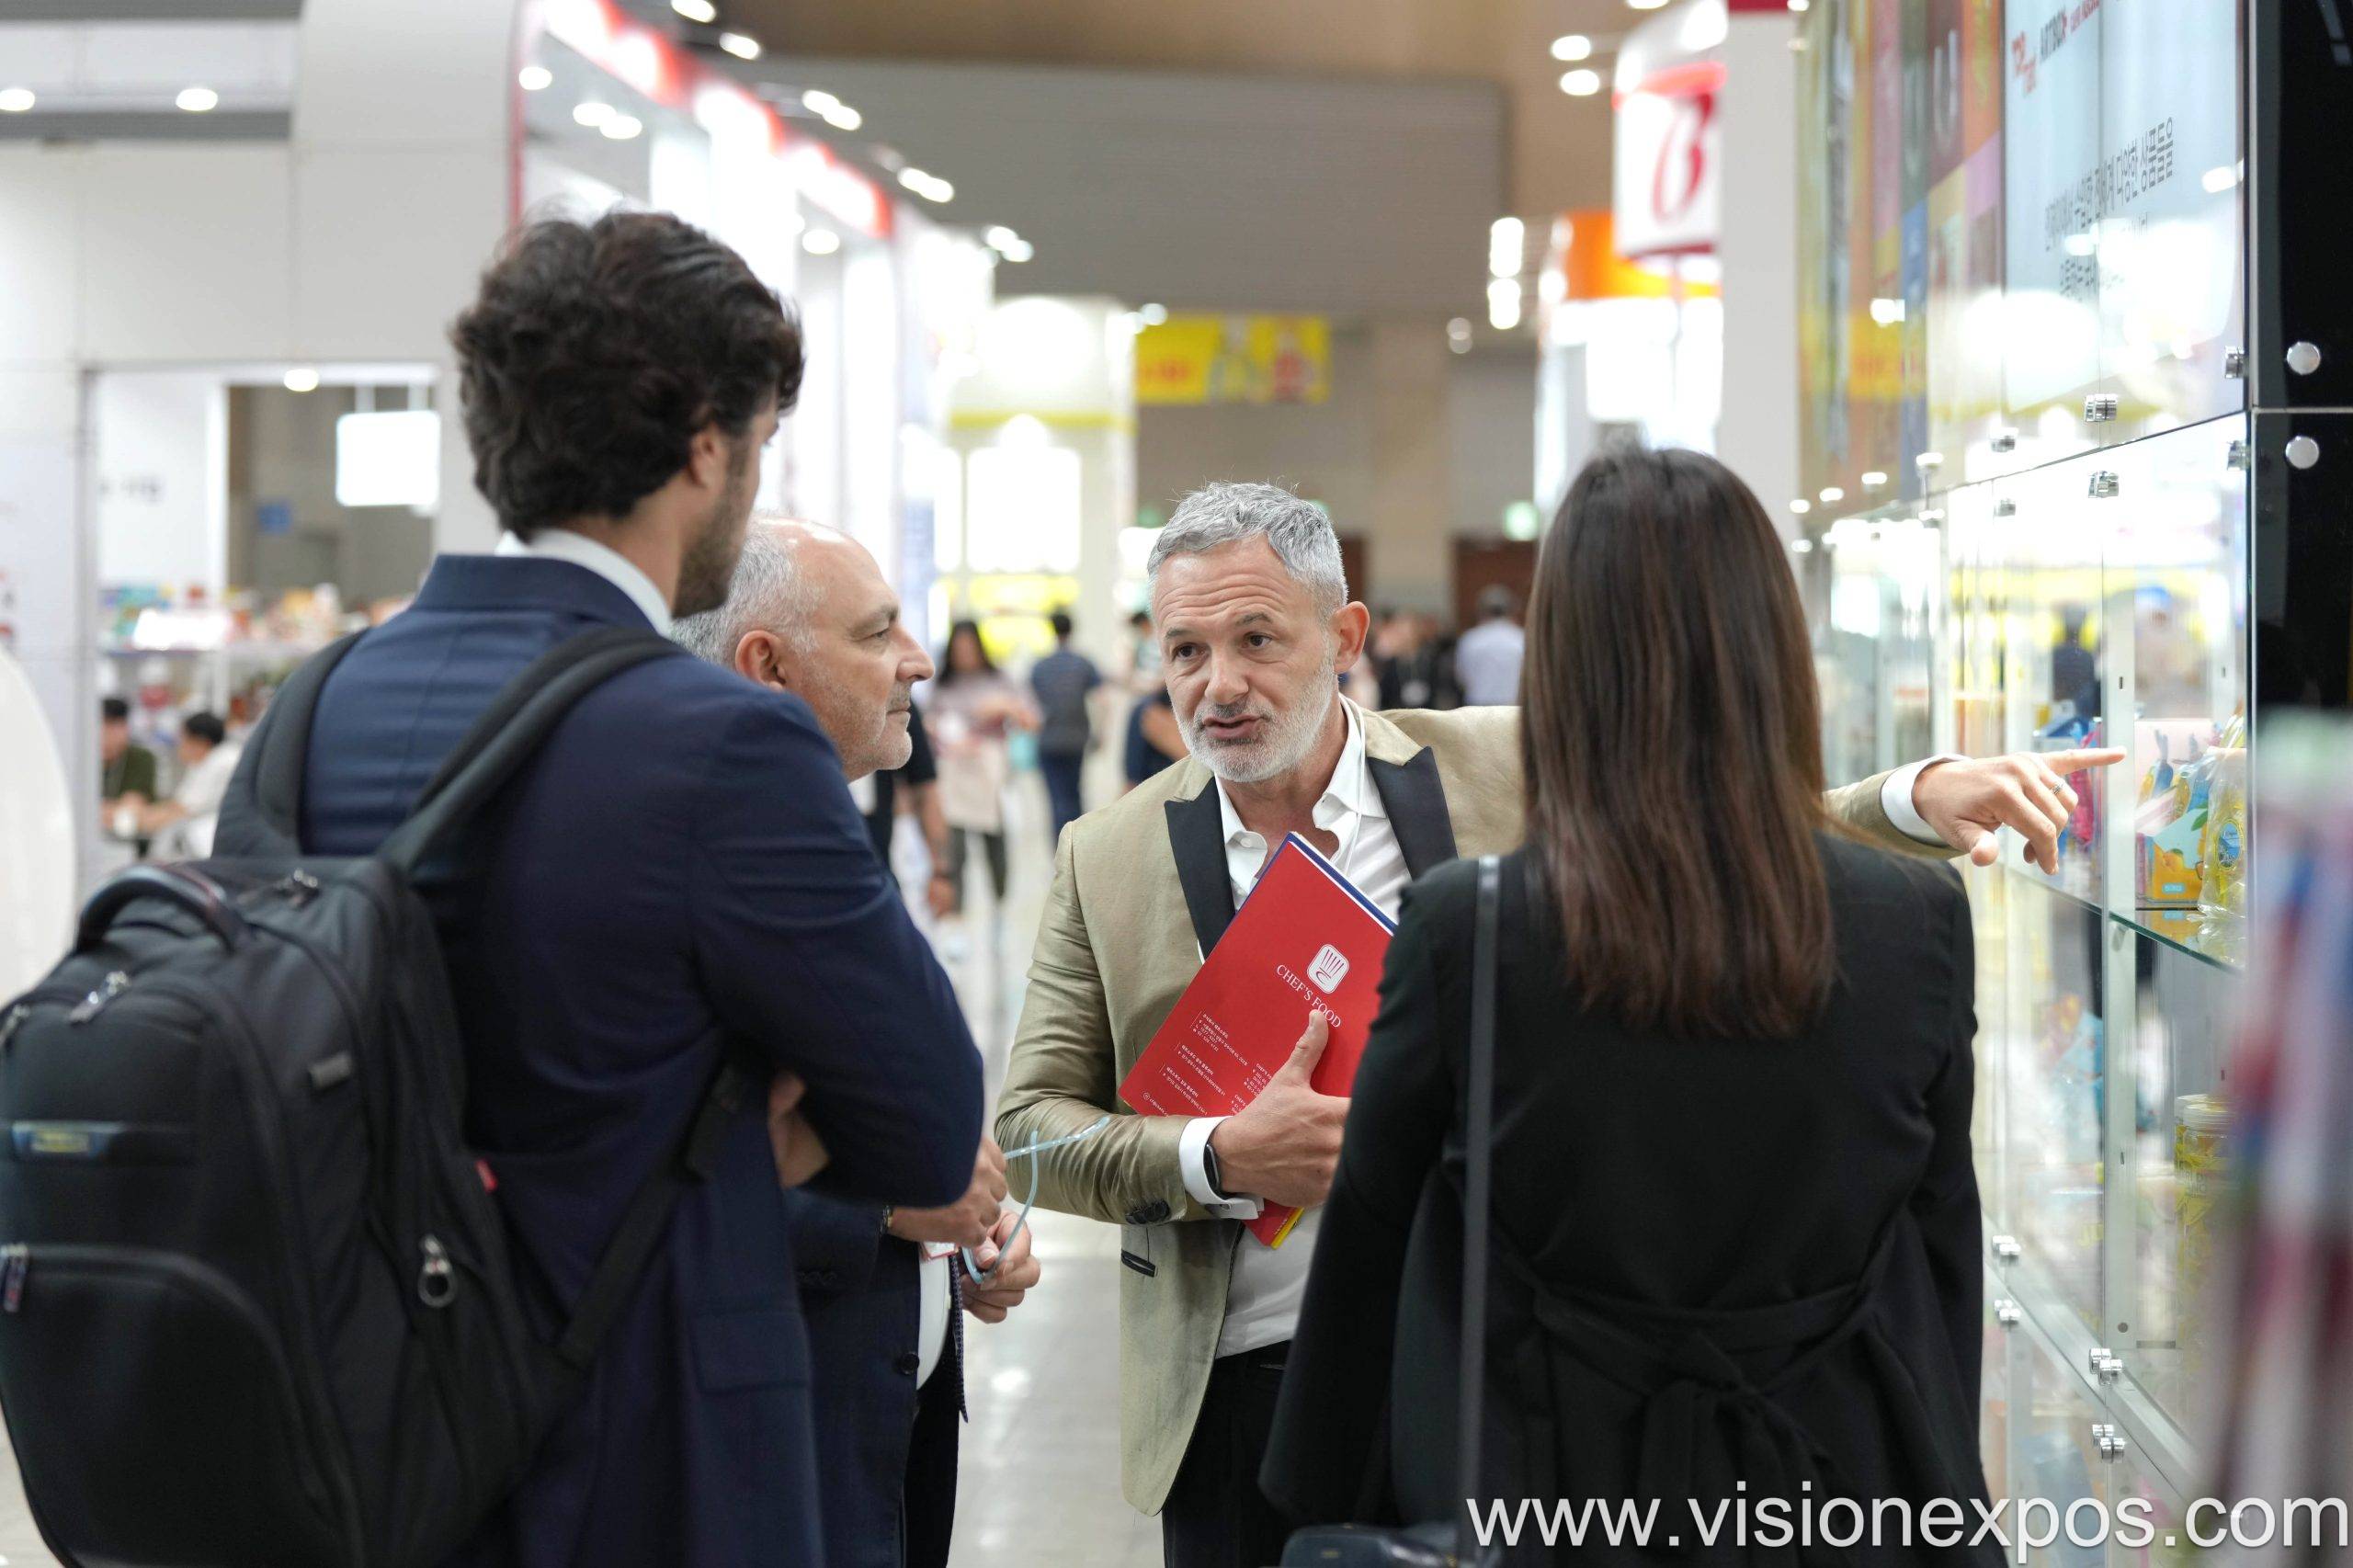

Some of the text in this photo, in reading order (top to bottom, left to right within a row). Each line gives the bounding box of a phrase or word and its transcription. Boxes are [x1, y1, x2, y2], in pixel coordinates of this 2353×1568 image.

[2117, 138, 2138, 206] 다양한
[2141, 117, 2174, 192] 상품들을
[1277, 965, 1341, 1028] CHEF'S FOOD
